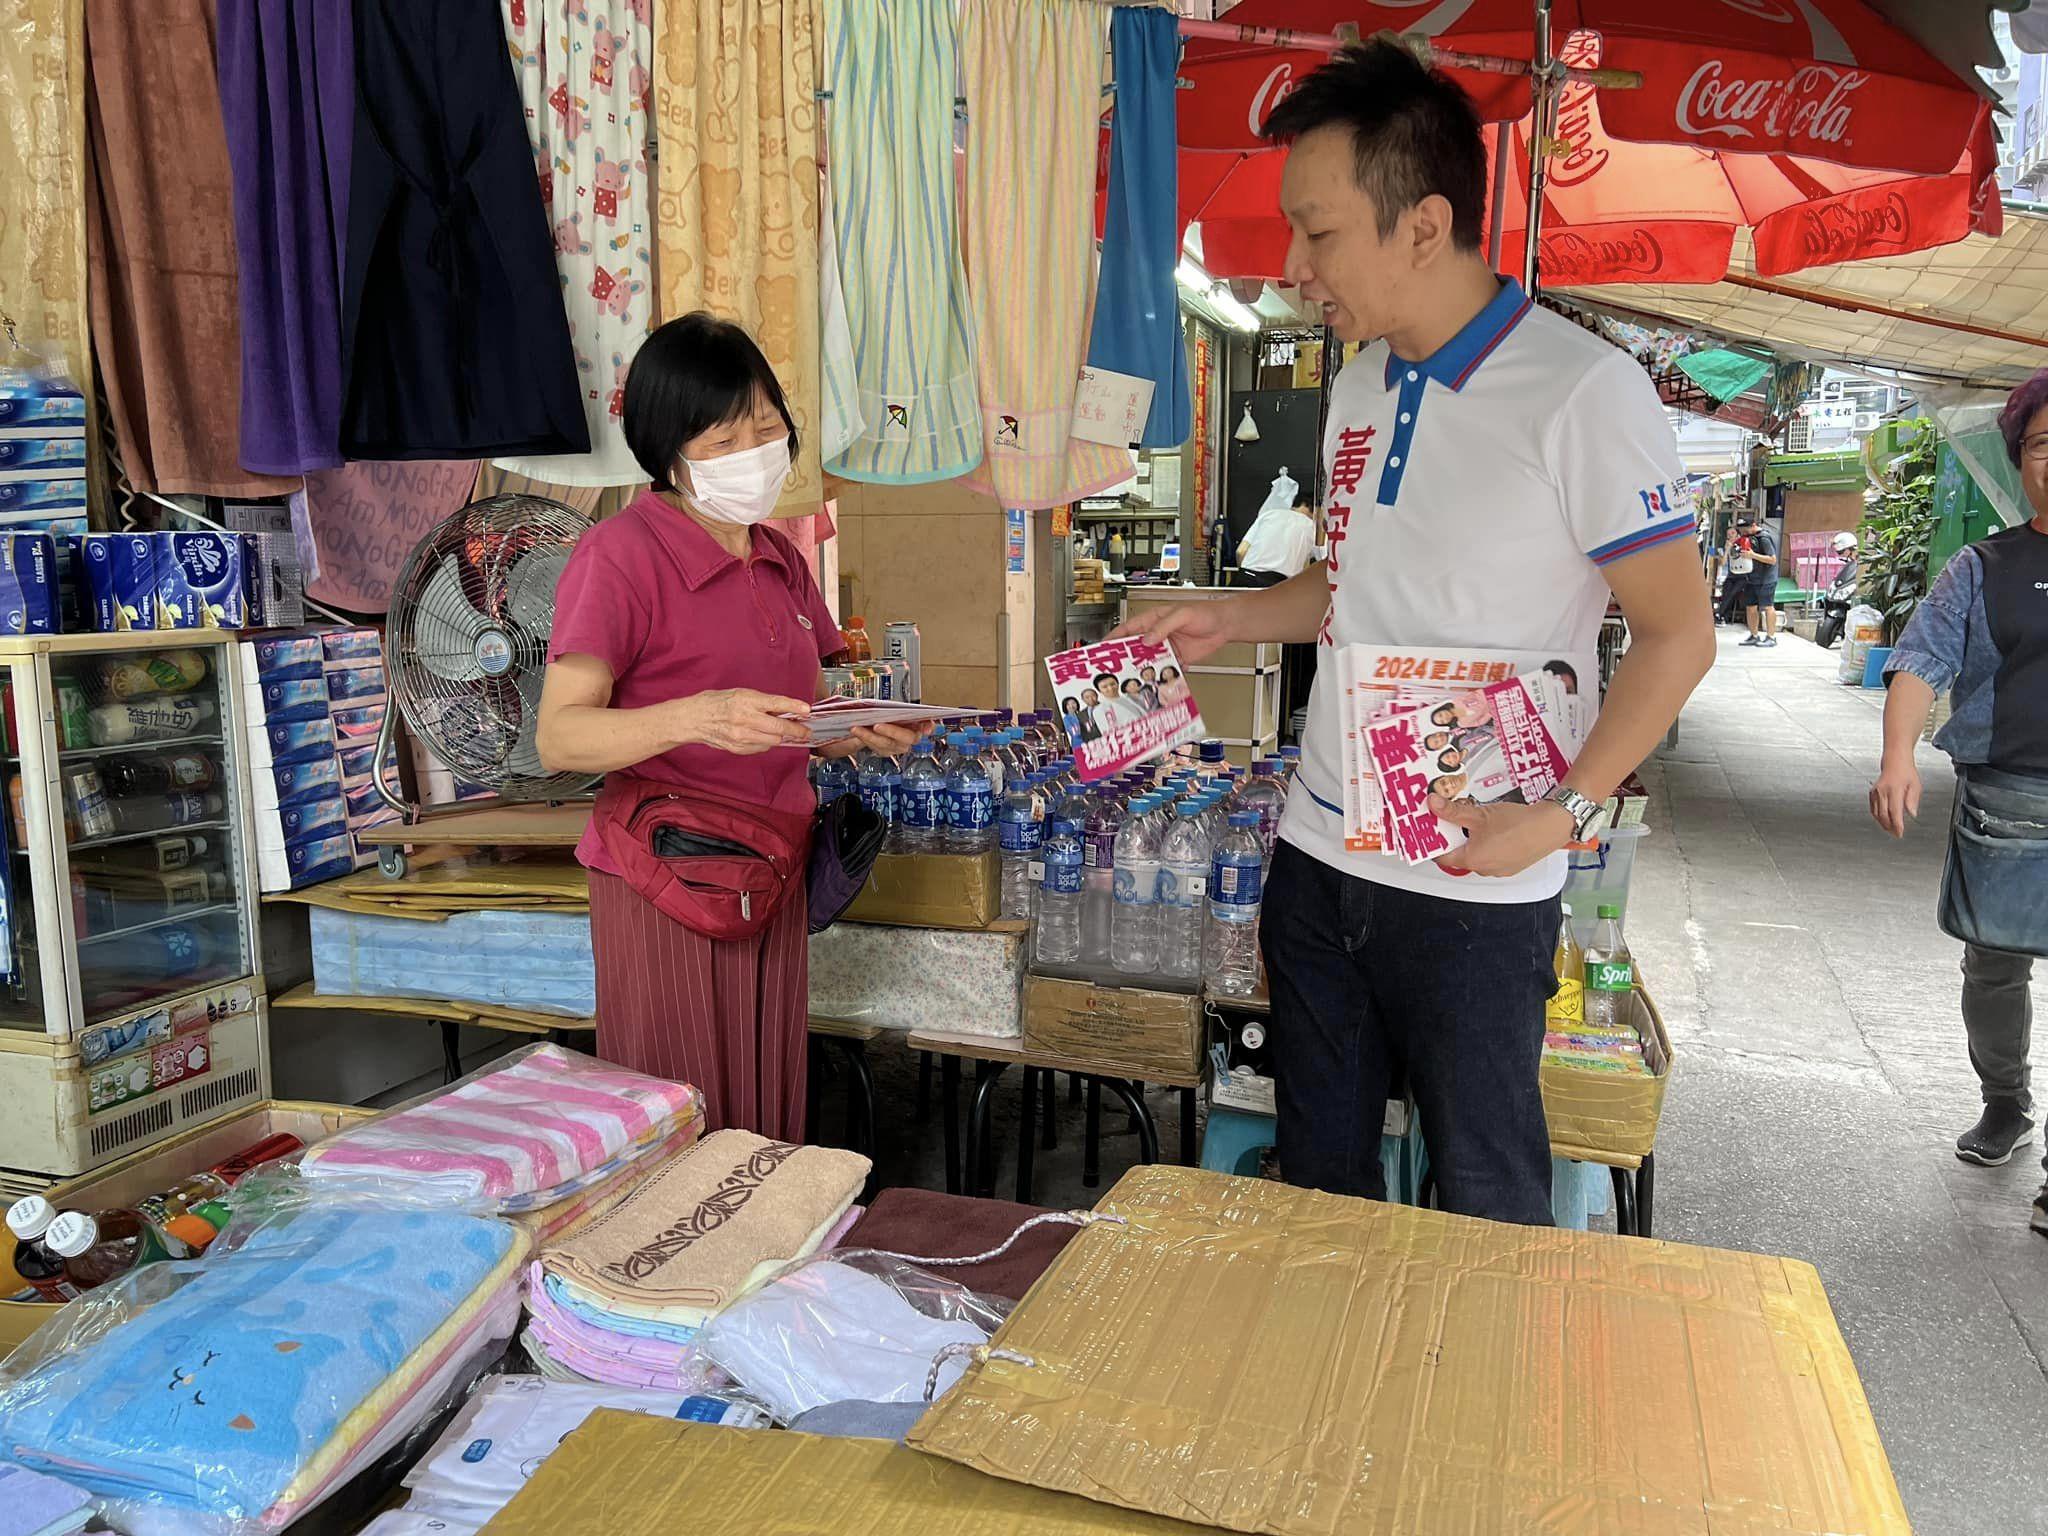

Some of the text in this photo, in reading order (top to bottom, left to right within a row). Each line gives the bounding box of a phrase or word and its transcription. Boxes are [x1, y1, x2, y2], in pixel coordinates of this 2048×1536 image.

[1675, 60, 1870, 142] Coca-Cola
[34, 556, 46, 584] CLASSIC
[184, 538, 204, 577] Vinda
[32, 618, 45, 628] 4
[126, 706, 193, 731] 維他奶
[1528, 713, 1551, 763] REPORT
[1369, 718, 1450, 863] 黃守東
